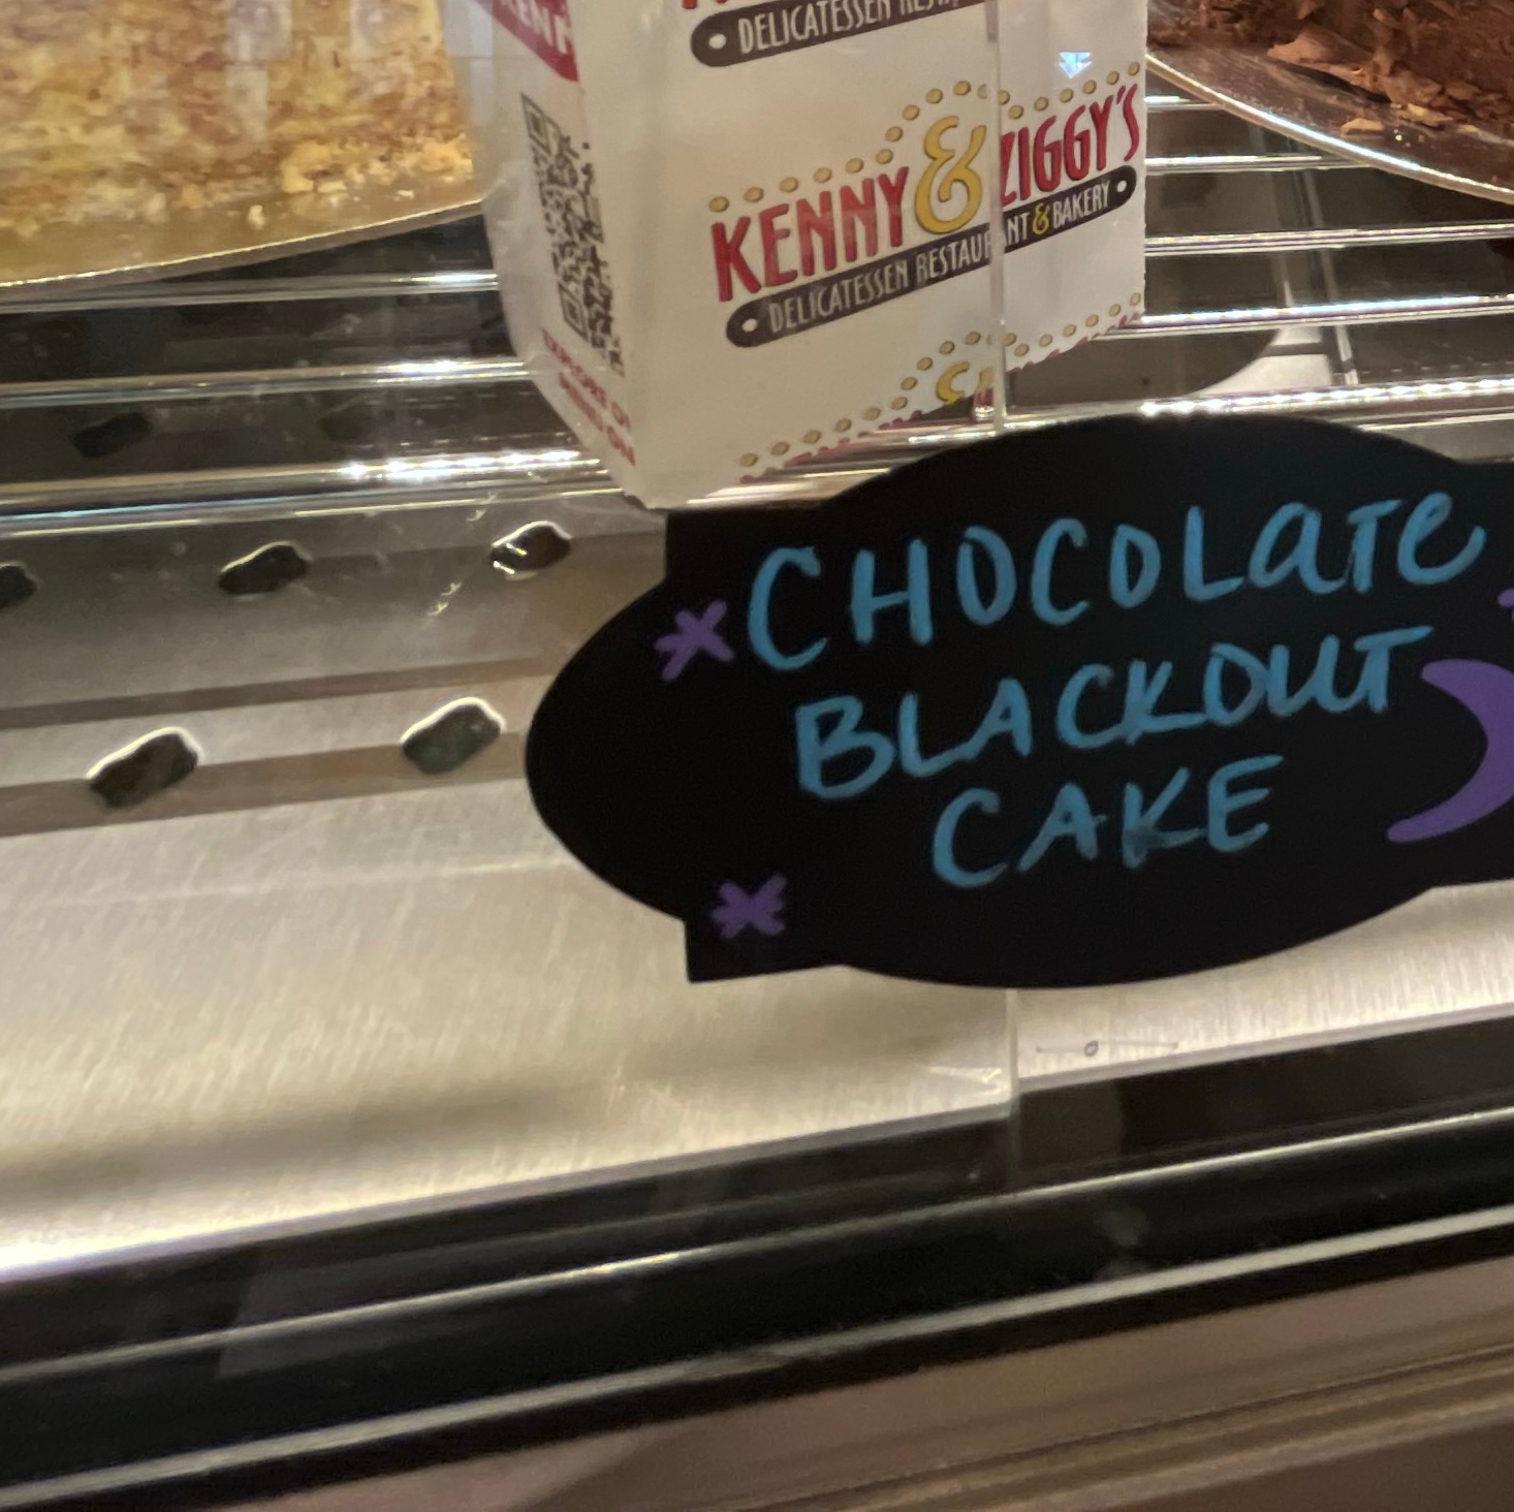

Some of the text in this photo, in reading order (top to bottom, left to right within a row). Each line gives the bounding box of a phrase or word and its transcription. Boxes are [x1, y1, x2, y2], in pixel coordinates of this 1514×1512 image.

[711, 83, 1140, 303] KENNY & ZIGGY'S
[768, 258, 910, 334] DELICATESSEN
[1032, 202, 1051, 236] &
[1053, 179, 1111, 230] BAKERY
[932, 755, 1284, 885] CAKE
